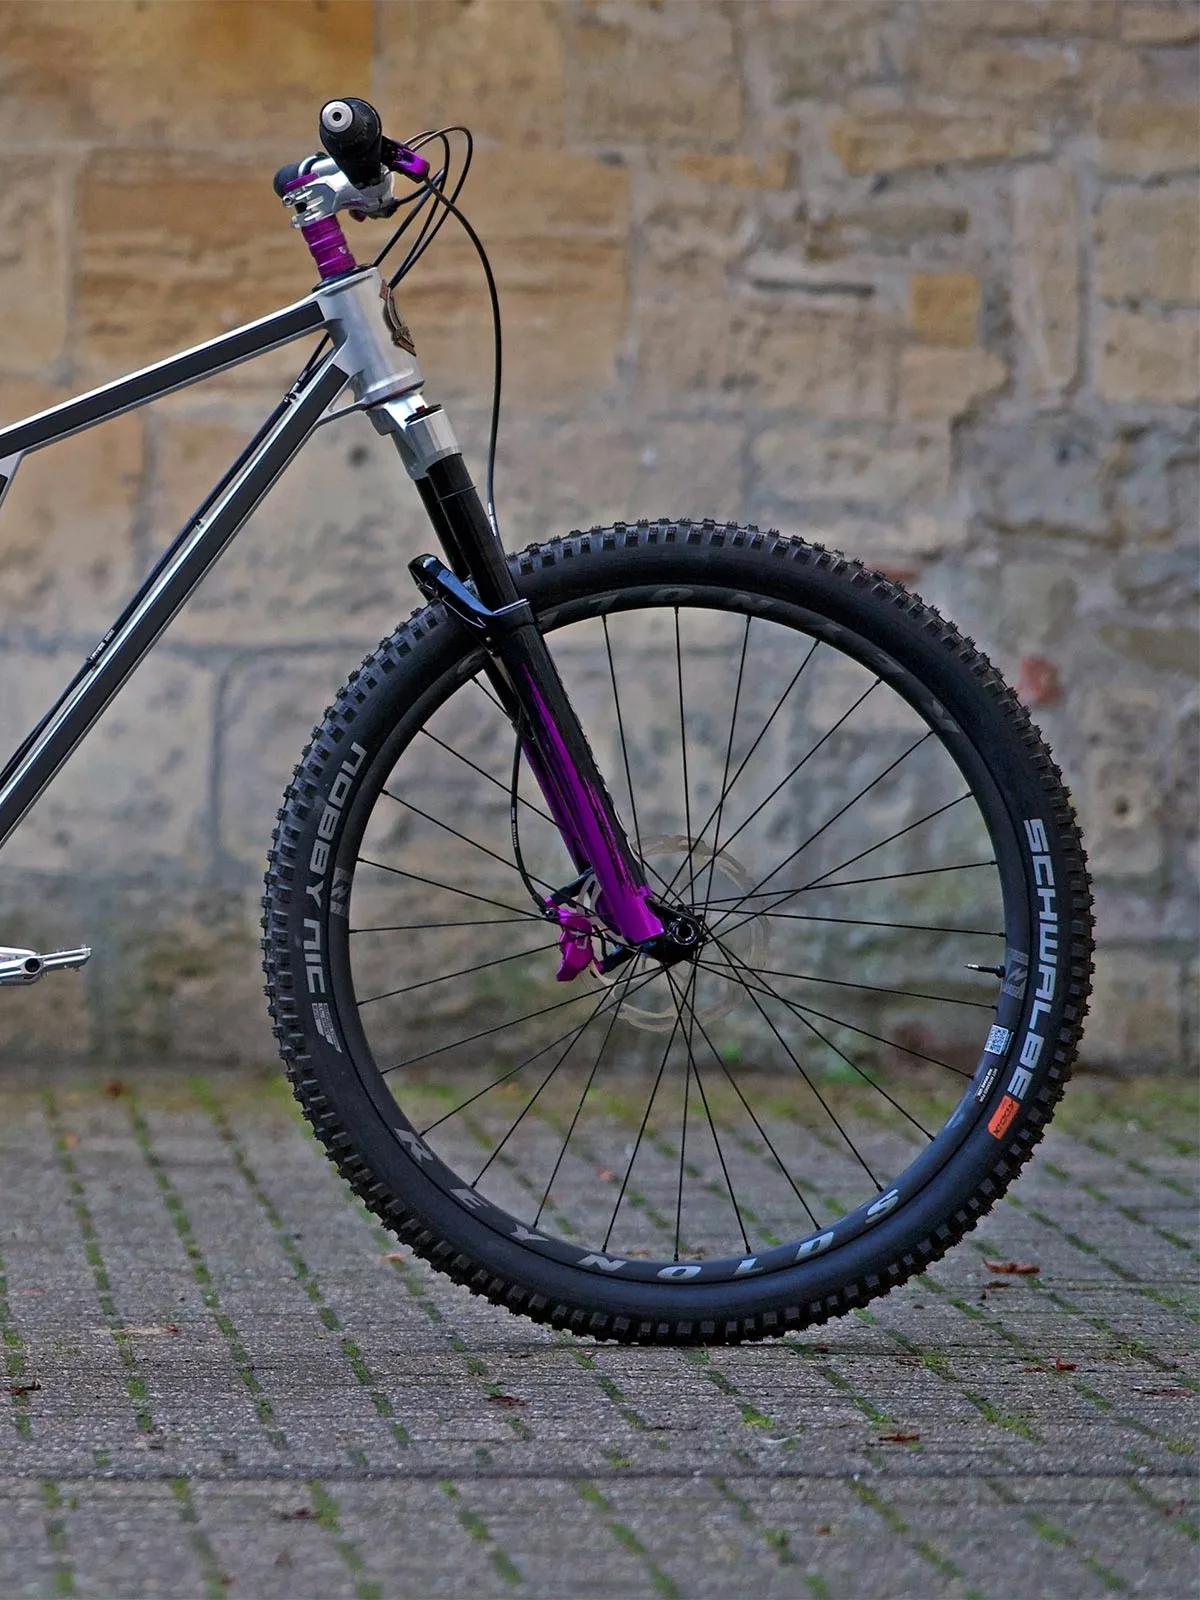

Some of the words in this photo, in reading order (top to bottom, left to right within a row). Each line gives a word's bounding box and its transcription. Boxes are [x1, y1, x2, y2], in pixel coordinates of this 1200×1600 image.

[305, 741, 368, 909] NOBBY
[303, 917, 326, 994] NIC
[1007, 818, 1057, 1101] SCHWALBE
[392, 1128, 900, 1282] REYNOLDS
